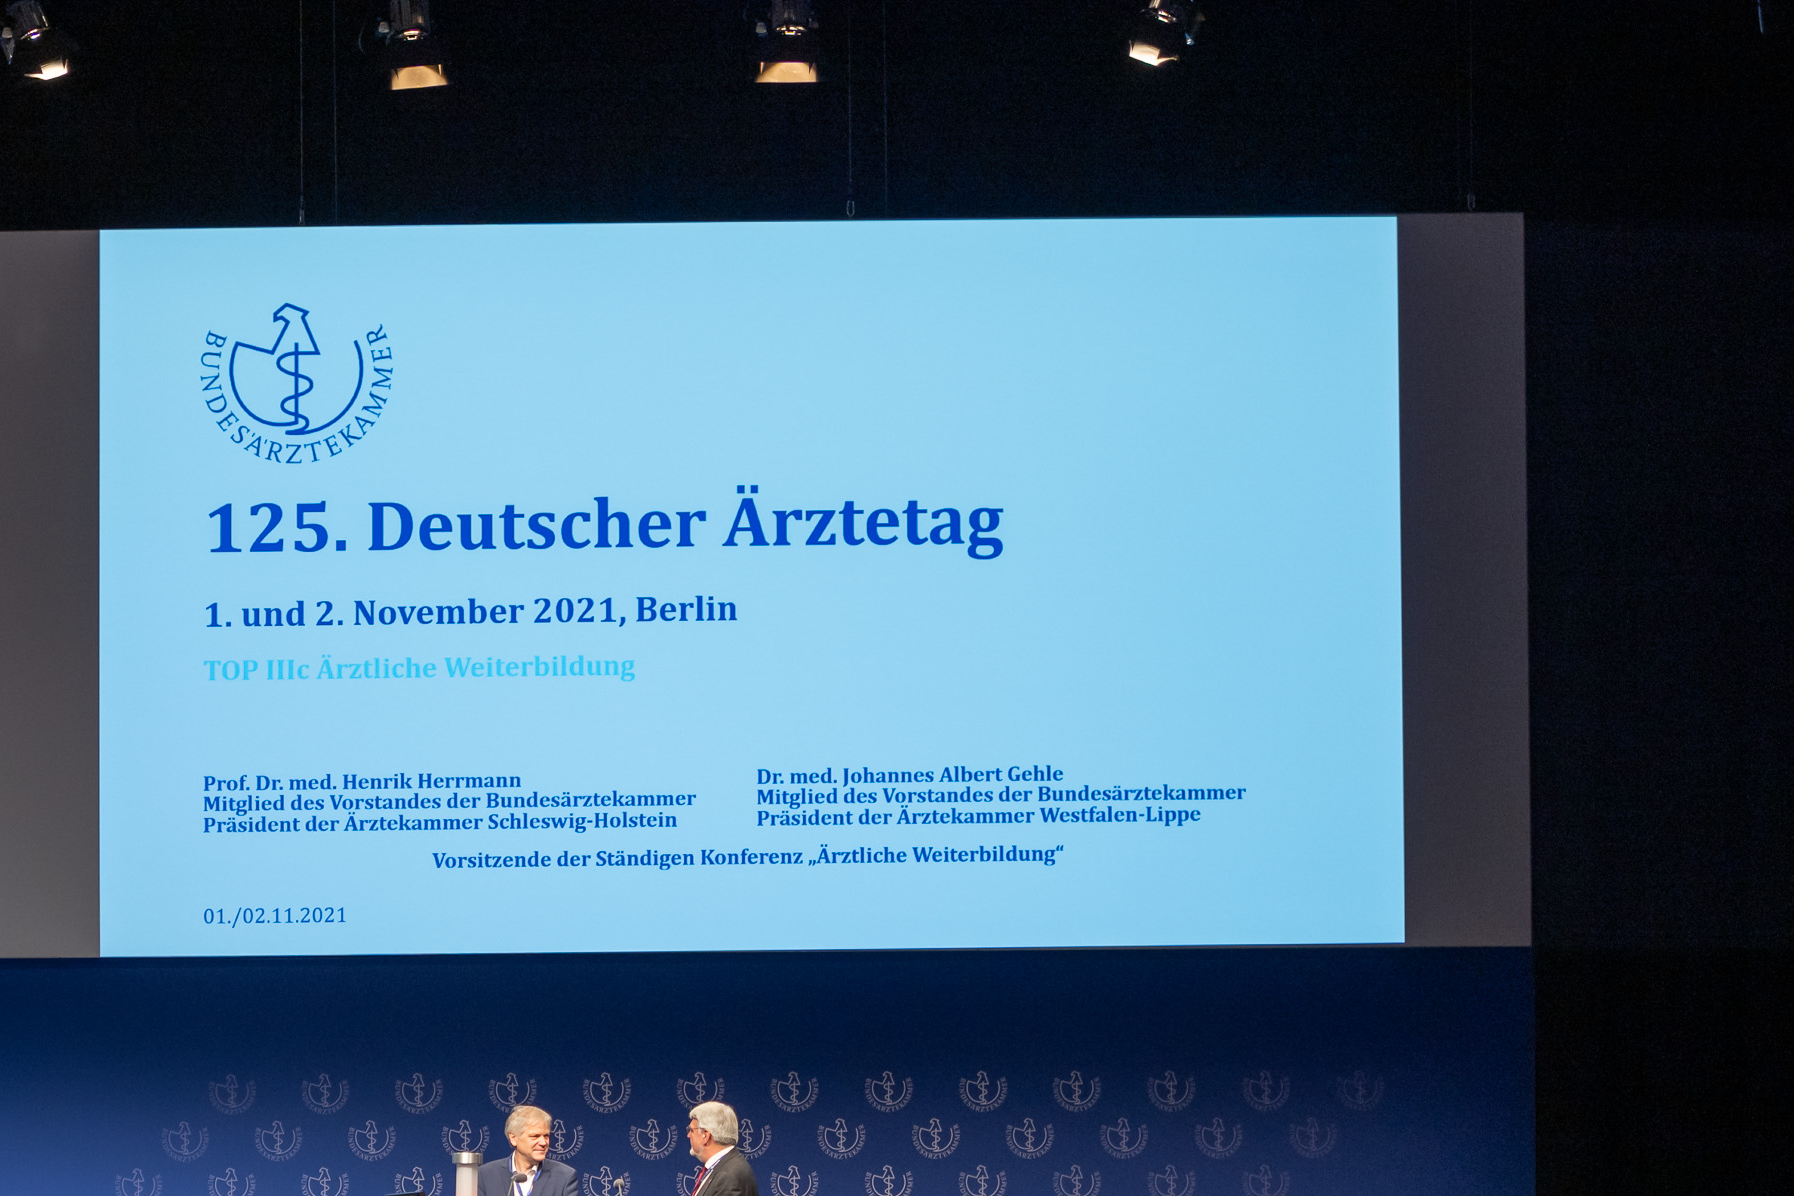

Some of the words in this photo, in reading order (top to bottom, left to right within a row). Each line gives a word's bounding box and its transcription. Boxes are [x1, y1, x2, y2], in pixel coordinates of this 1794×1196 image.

[200, 322, 394, 464] BUNDESÄRZTEKAMMER
[209, 501, 346, 552] 125.
[368, 497, 706, 550] Deutscher
[722, 485, 1003, 560] Ärztetag
[206, 603, 231, 627] 1.
[242, 601, 305, 626] und
[316, 601, 343, 625] 2.
[354, 598, 524, 625] November
[534, 598, 626, 629] 2021,
[636, 596, 737, 622] Berlin
[204, 660, 258, 680] TOP
[268, 660, 309, 680] IIIc
[317, 655, 436, 679] Ärztliche
[445, 655, 635, 681] Weiterbildung
[204, 775, 249, 791] Prof.
[256, 776, 283, 790] Dr.
[289, 774, 336, 790] med.
[343, 773, 412, 789] Henrik
[419, 774, 521, 788] Herrmann
[758, 769, 784, 784] Dr.
[790, 768, 837, 784] med.
[843, 767, 934, 787] Johannes
[939, 766, 1002, 782] Albert
[1008, 765, 1063, 781] Gehle
[204, 795, 284, 816] Mitglied
[291, 795, 324, 810] des
[330, 793, 441, 810] Vorstandes
[447, 793, 480, 808] der
[487, 791, 696, 808] Bundesärztekammer
[758, 788, 837, 809] Mitglied
[844, 788, 877, 803] des
[883, 786, 993, 803] Vorstandes
[999, 786, 1032, 802] der
[1038, 784, 1246, 801] Bundesärztekammer
[204, 816, 300, 833] Präsident
[306, 816, 339, 831] der
[344, 812, 483, 831] Ärztekammer
[488, 812, 677, 833] Schleswig-Holstein
[758, 809, 853, 826] Präsident
[859, 809, 892, 824] der
[897, 805, 1035, 824] Ärztekammer
[1040, 806, 1200, 826] Westfalen-Lippe
[432, 851, 551, 868] Vorsitzende
[557, 851, 591, 866] der
[596, 850, 694, 870] Ständigen
[701, 848, 803, 865] Konferenz
[809, 844, 907, 866] „Ärztliche
[912, 845, 1063, 866] Weiterbildung“
[204, 907, 345, 928] 01./02.11.2021
